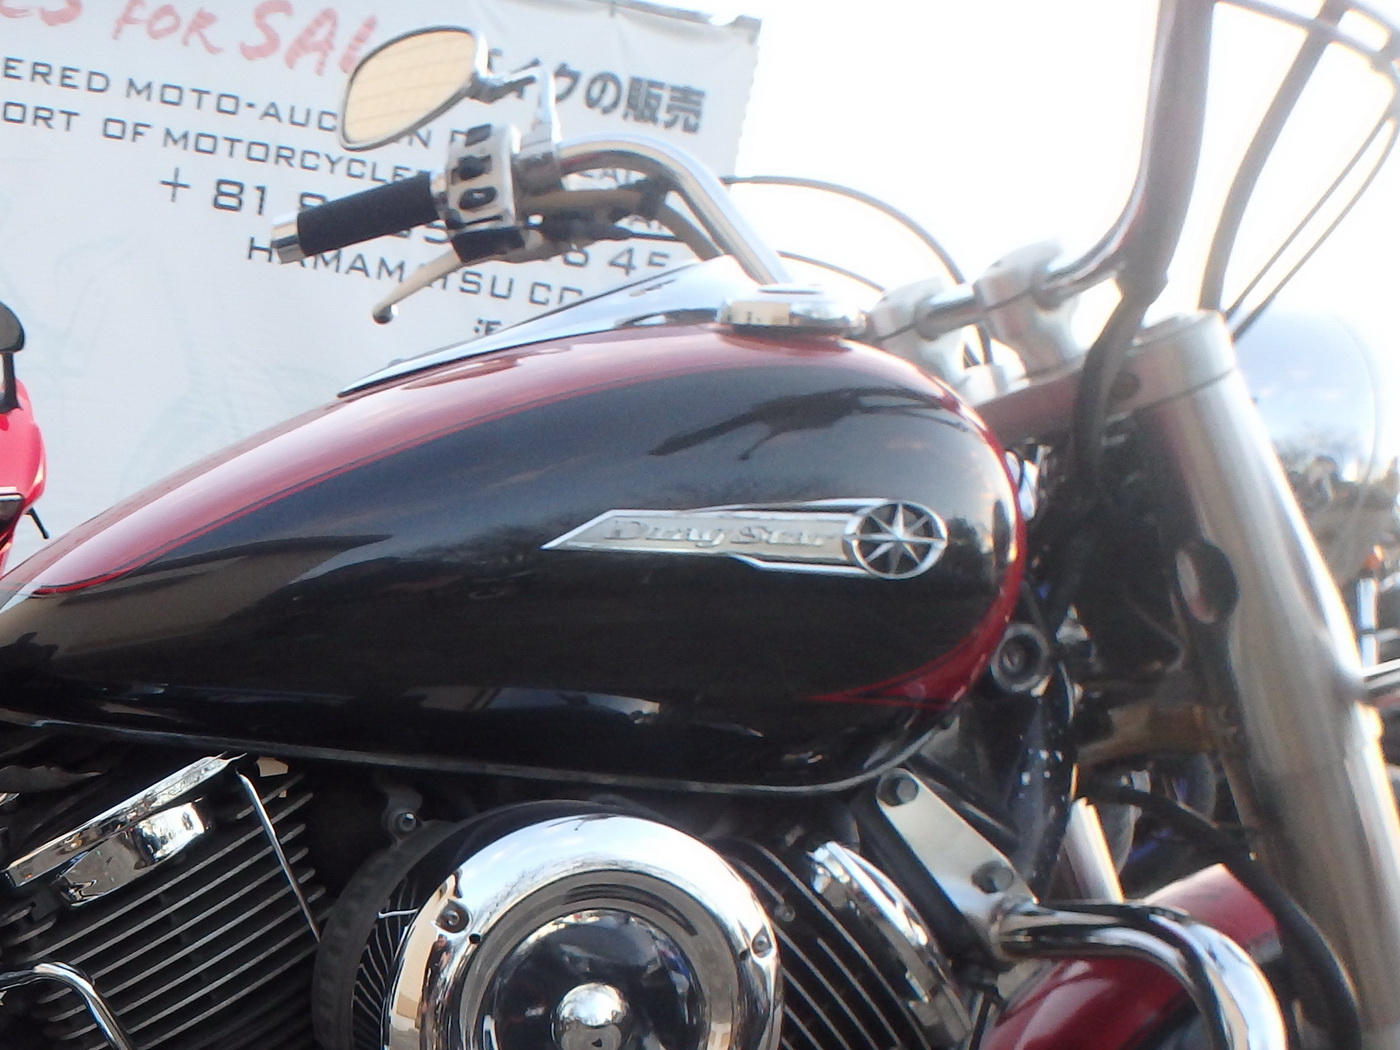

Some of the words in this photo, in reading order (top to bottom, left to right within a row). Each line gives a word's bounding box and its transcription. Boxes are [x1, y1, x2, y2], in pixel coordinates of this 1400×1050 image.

[112, 0, 224, 55] FOR
[102, 116, 151, 144] OF
[212, 179, 268, 216] 81
